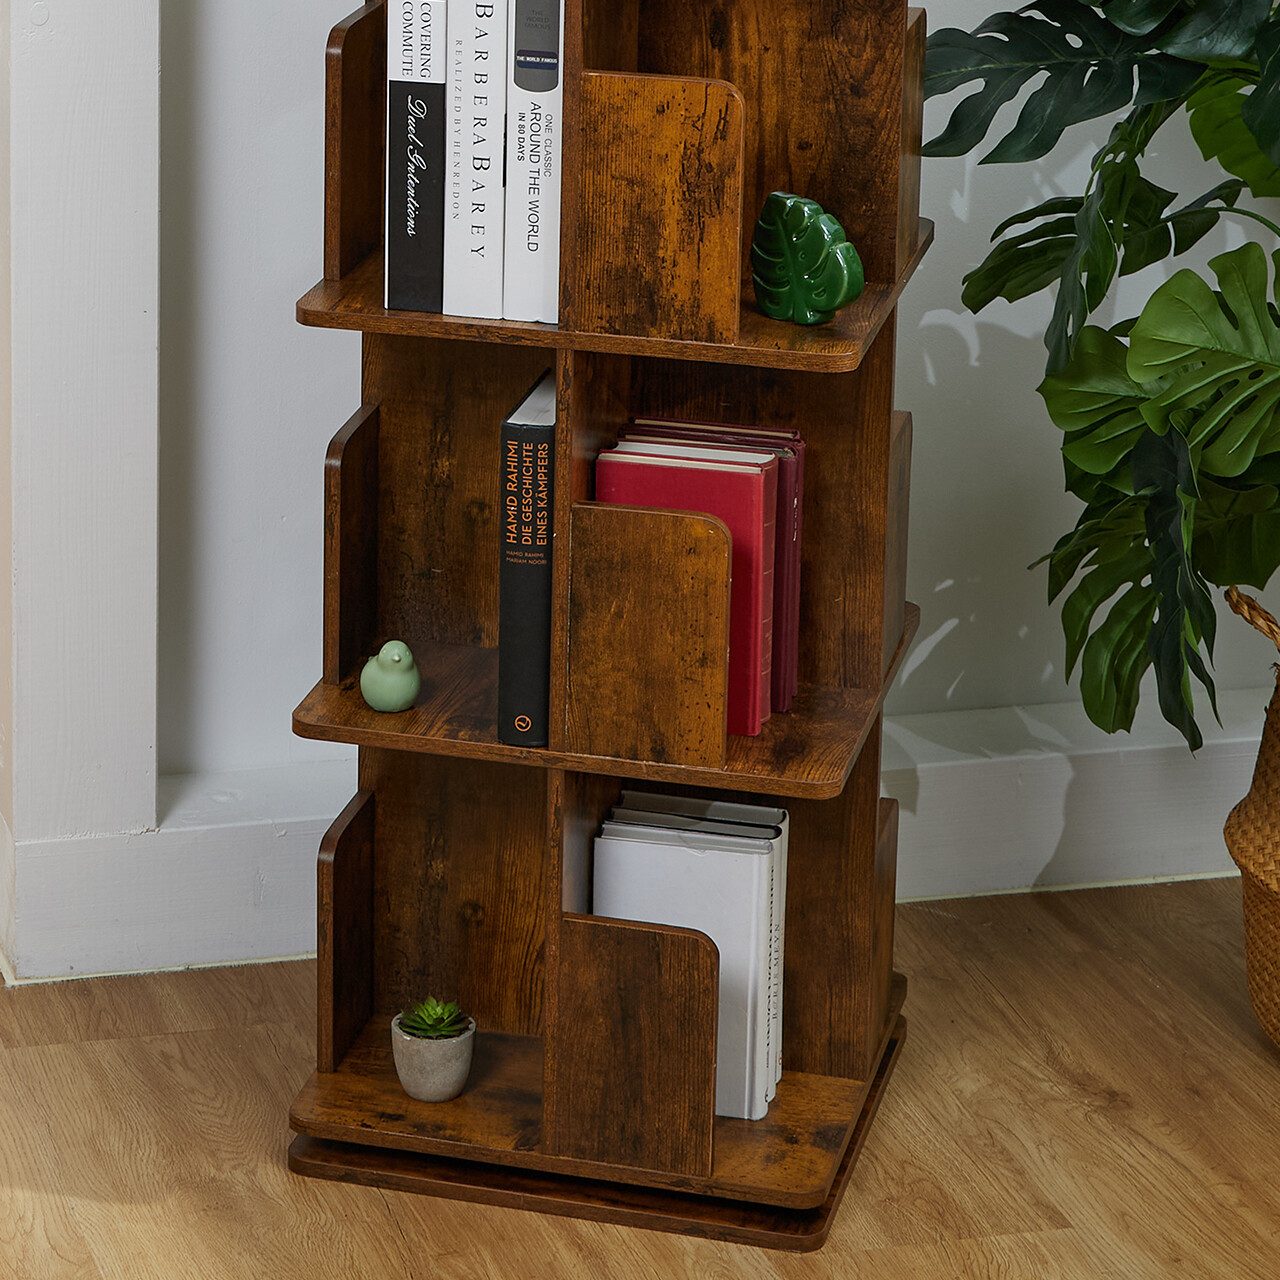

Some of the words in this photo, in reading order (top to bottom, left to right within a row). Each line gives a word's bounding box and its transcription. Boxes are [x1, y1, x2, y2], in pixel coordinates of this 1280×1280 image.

[402, 1, 414, 77] COMMUTE
[420, 2, 432, 78] COVERING
[453, 39, 463, 113] REALIZED
[453, 119, 461, 135] BY
[517, 124, 525, 134] 80
[518, 112, 526, 122] IN
[529, 101, 542, 164] AROUND
[544, 113, 553, 134] ONE
[517, 137, 525, 162] DAYS
[543, 139, 553, 178] CLASSIC
[452, 141, 461, 220] HENREDON
[528, 167, 540, 196] THE
[527, 199, 540, 252] WORLD
[506, 440, 518, 491] RAHIMI
[521, 442, 533, 522] GESCHICHTE
[535, 442, 549, 508] KÄMPFERS
[506, 495, 517, 544] HAMID
[521, 525, 532, 545] DIE
[536, 510, 548, 545] EINES
